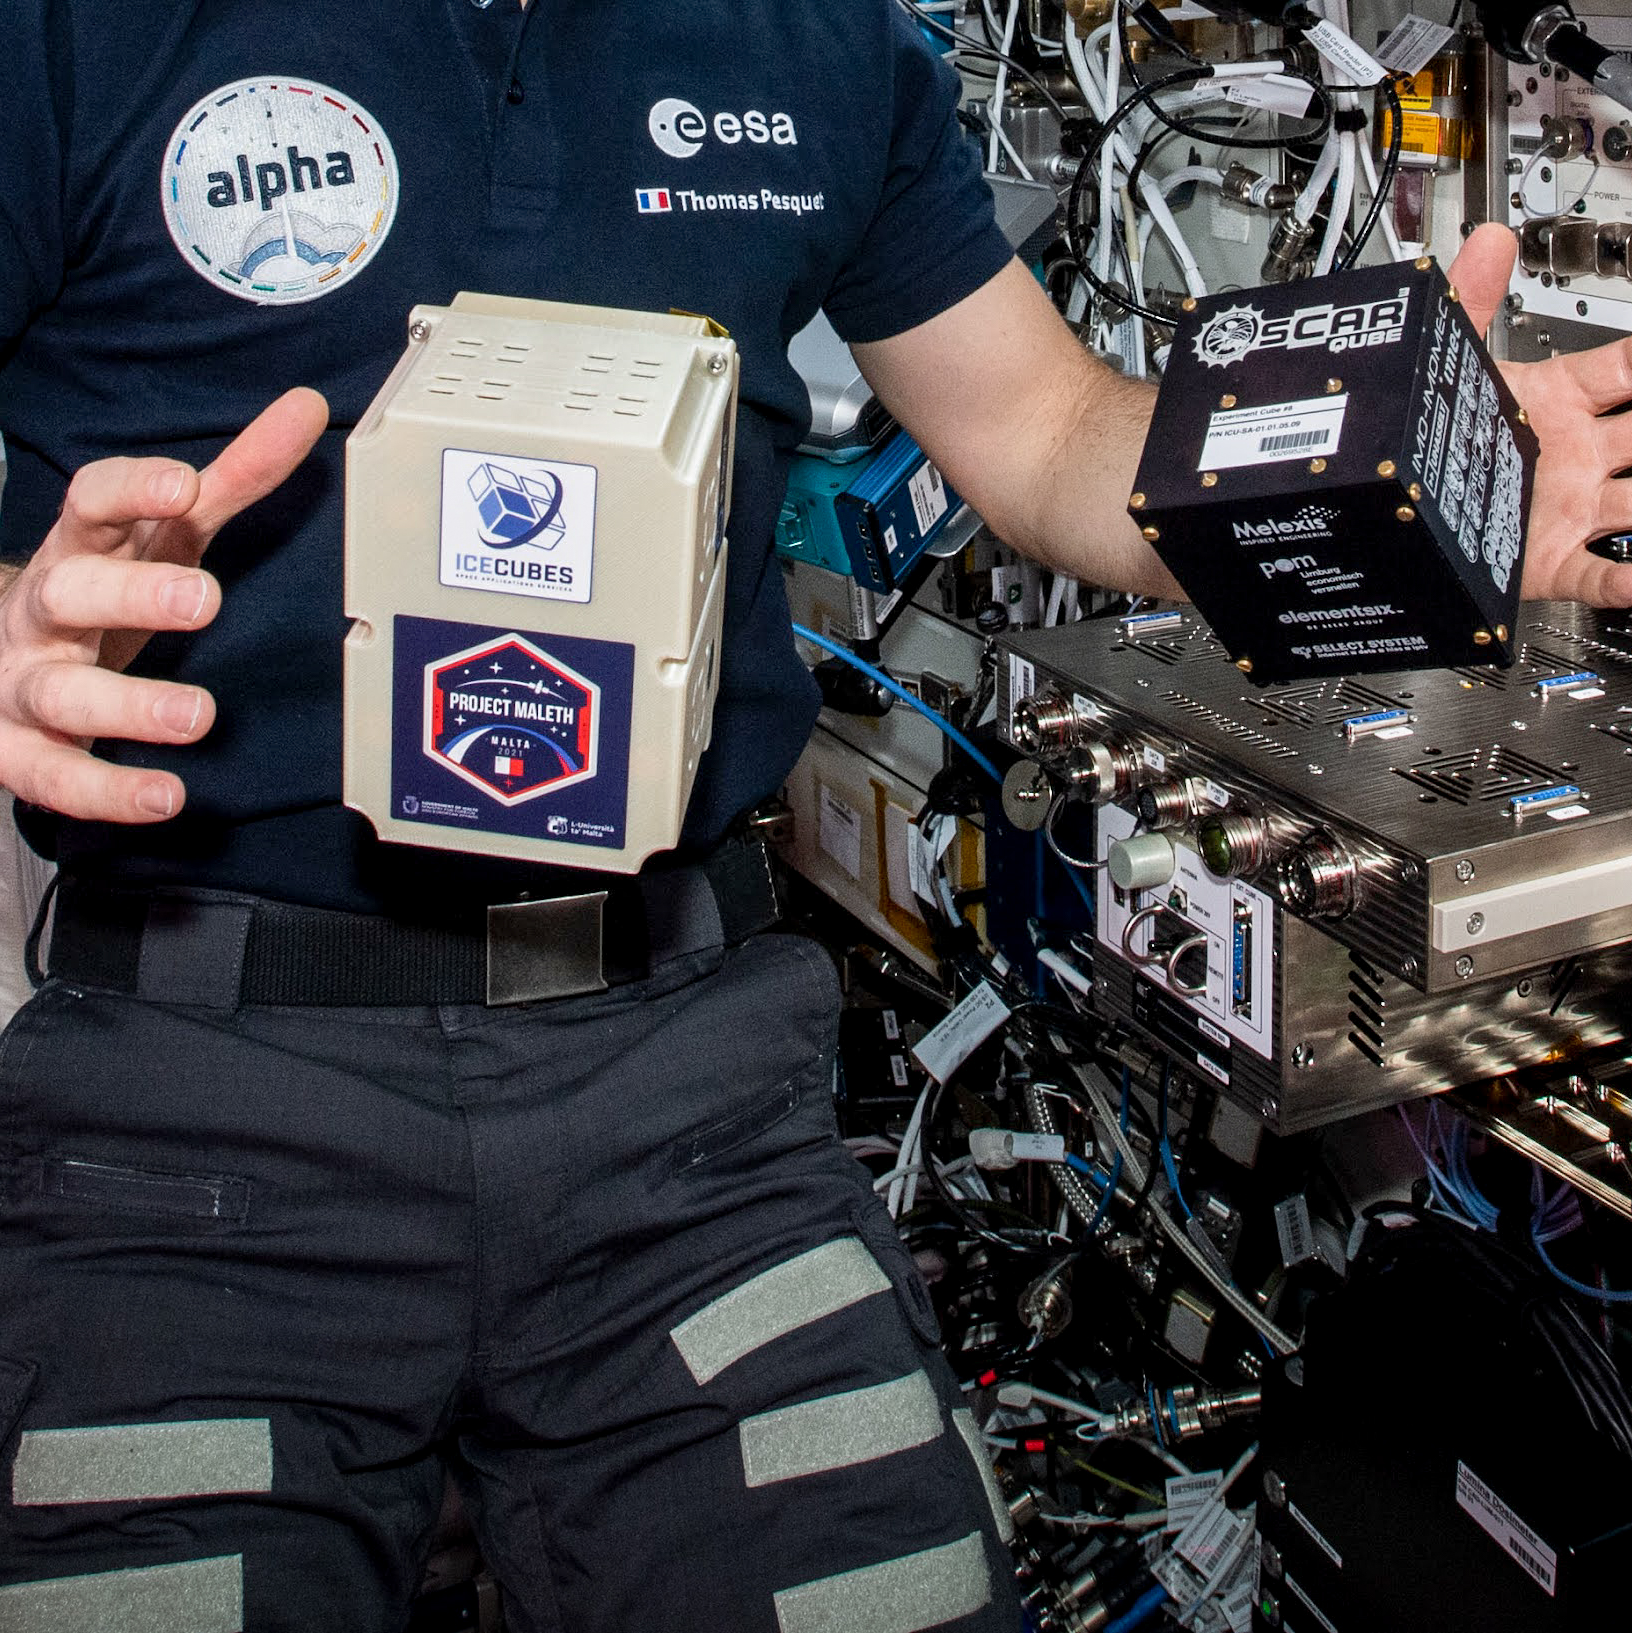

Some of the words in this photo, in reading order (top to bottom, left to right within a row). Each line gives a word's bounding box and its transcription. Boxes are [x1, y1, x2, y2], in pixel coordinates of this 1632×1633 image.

[713, 110, 798, 145] esa
[207, 146, 355, 211] alpha
[675, 190, 758, 212] Thomas
[760, 188, 825, 216] Pesquet
[1594, 191, 1620, 201] POWER
[1329, 329, 1402, 353] QUBE
[1439, 319, 1461, 385] imec
[1412, 296, 1448, 474] IMO-IMOMEC
[1213, 410, 1257, 422] Experiment
[1261, 407, 1281, 416] Cube
[1233, 518, 1327, 539] Melexis
[1240, 538, 1275, 546] INSPIRED
[1279, 531, 1333, 542] ENGINEERING
[456, 554, 573, 584] ICECUBES
[456, 573, 480, 582] SPACE
[1259, 555, 1317, 579] pom
[1300, 567, 1341, 578] Limburg
[1307, 571, 1364, 587] economisch
[1312, 581, 1360, 594] versnellen
[1312, 641, 1364, 653] SELECT
[1367, 636, 1426, 648] SYSTEM
[450, 692, 511, 716] PROJECT
[514, 701, 573, 725] MALETH
[491, 736, 531, 749] MALTA
[499, 747, 524, 757] 2021
[1459, 1464, 1490, 1500] Lumina
[1491, 1494, 1538, 1545] Dosimeter
